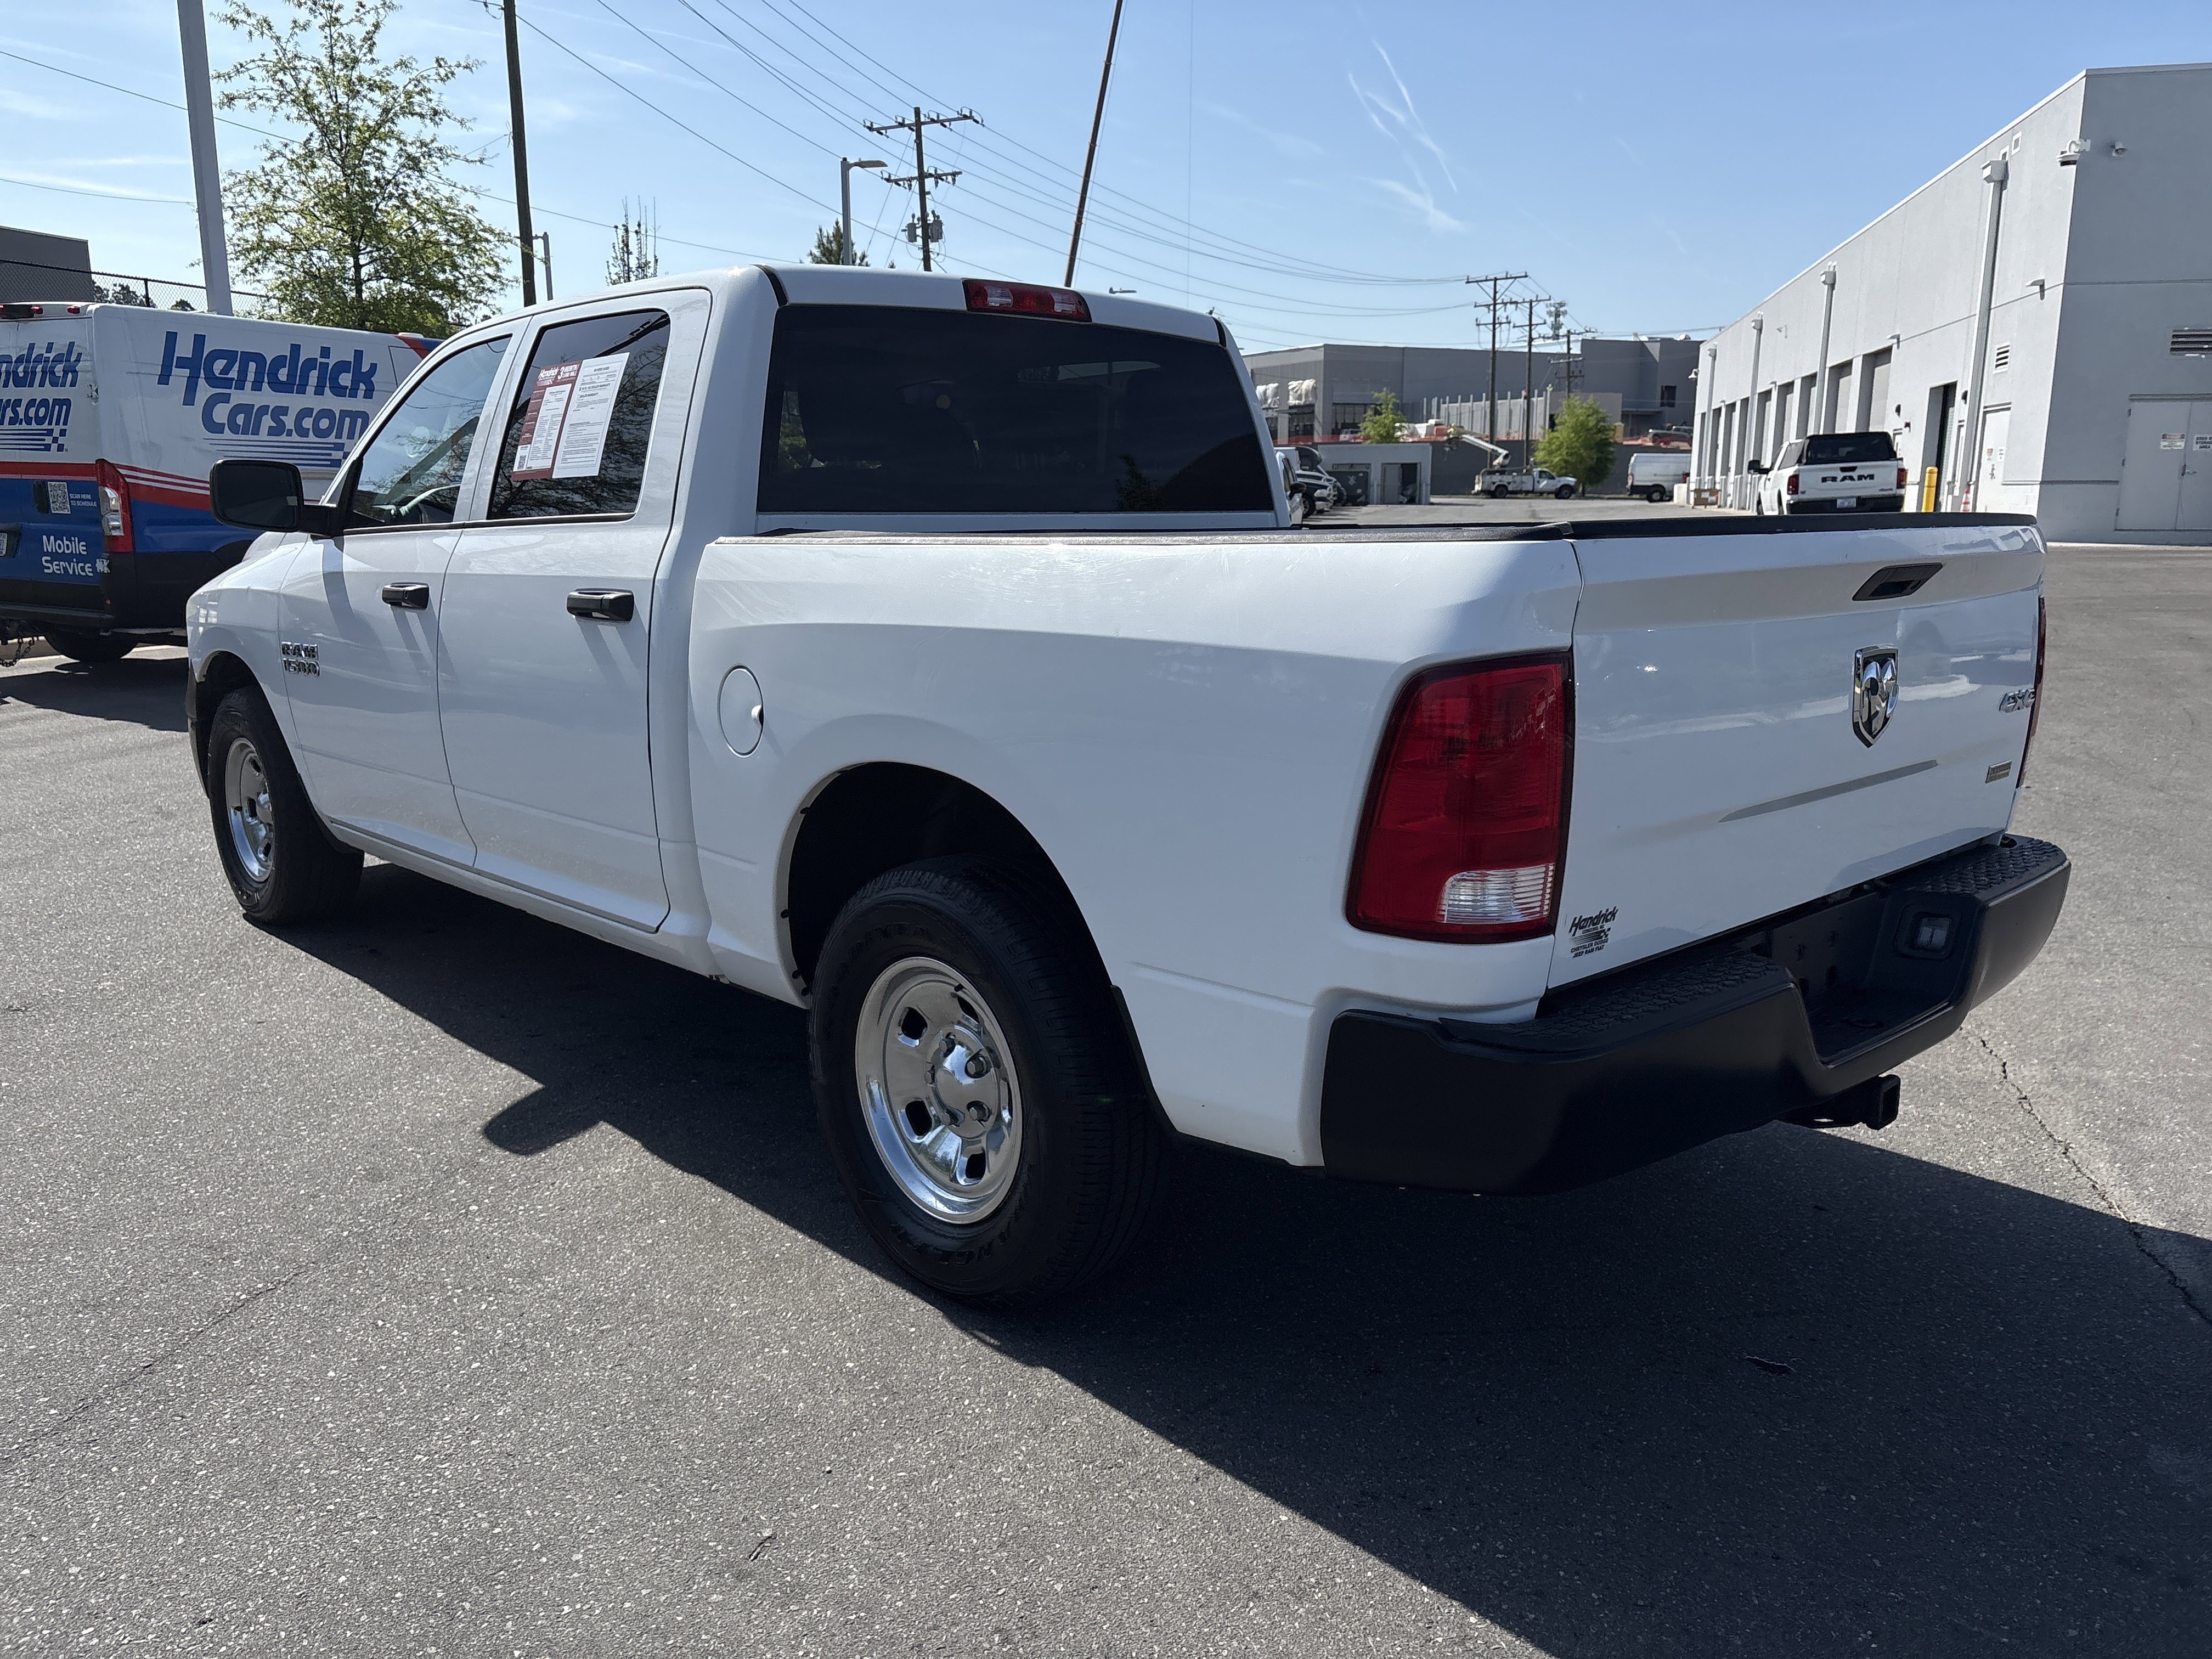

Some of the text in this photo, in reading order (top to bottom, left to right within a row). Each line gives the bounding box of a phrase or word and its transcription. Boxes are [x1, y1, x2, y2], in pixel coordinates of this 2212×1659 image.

[158, 331, 377, 406] Hendrick
[202, 392, 370, 439] Cars.com
[1821, 474, 1875, 483] RAM
[42, 535, 87, 555] Mobile
[42, 556, 93, 577] Service
[281, 641, 319, 658] RAM
[283, 658, 320, 676] 1500
[1568, 906, 1618, 936] Hendrick
[1571, 943, 1593, 953] CHRYSLER
